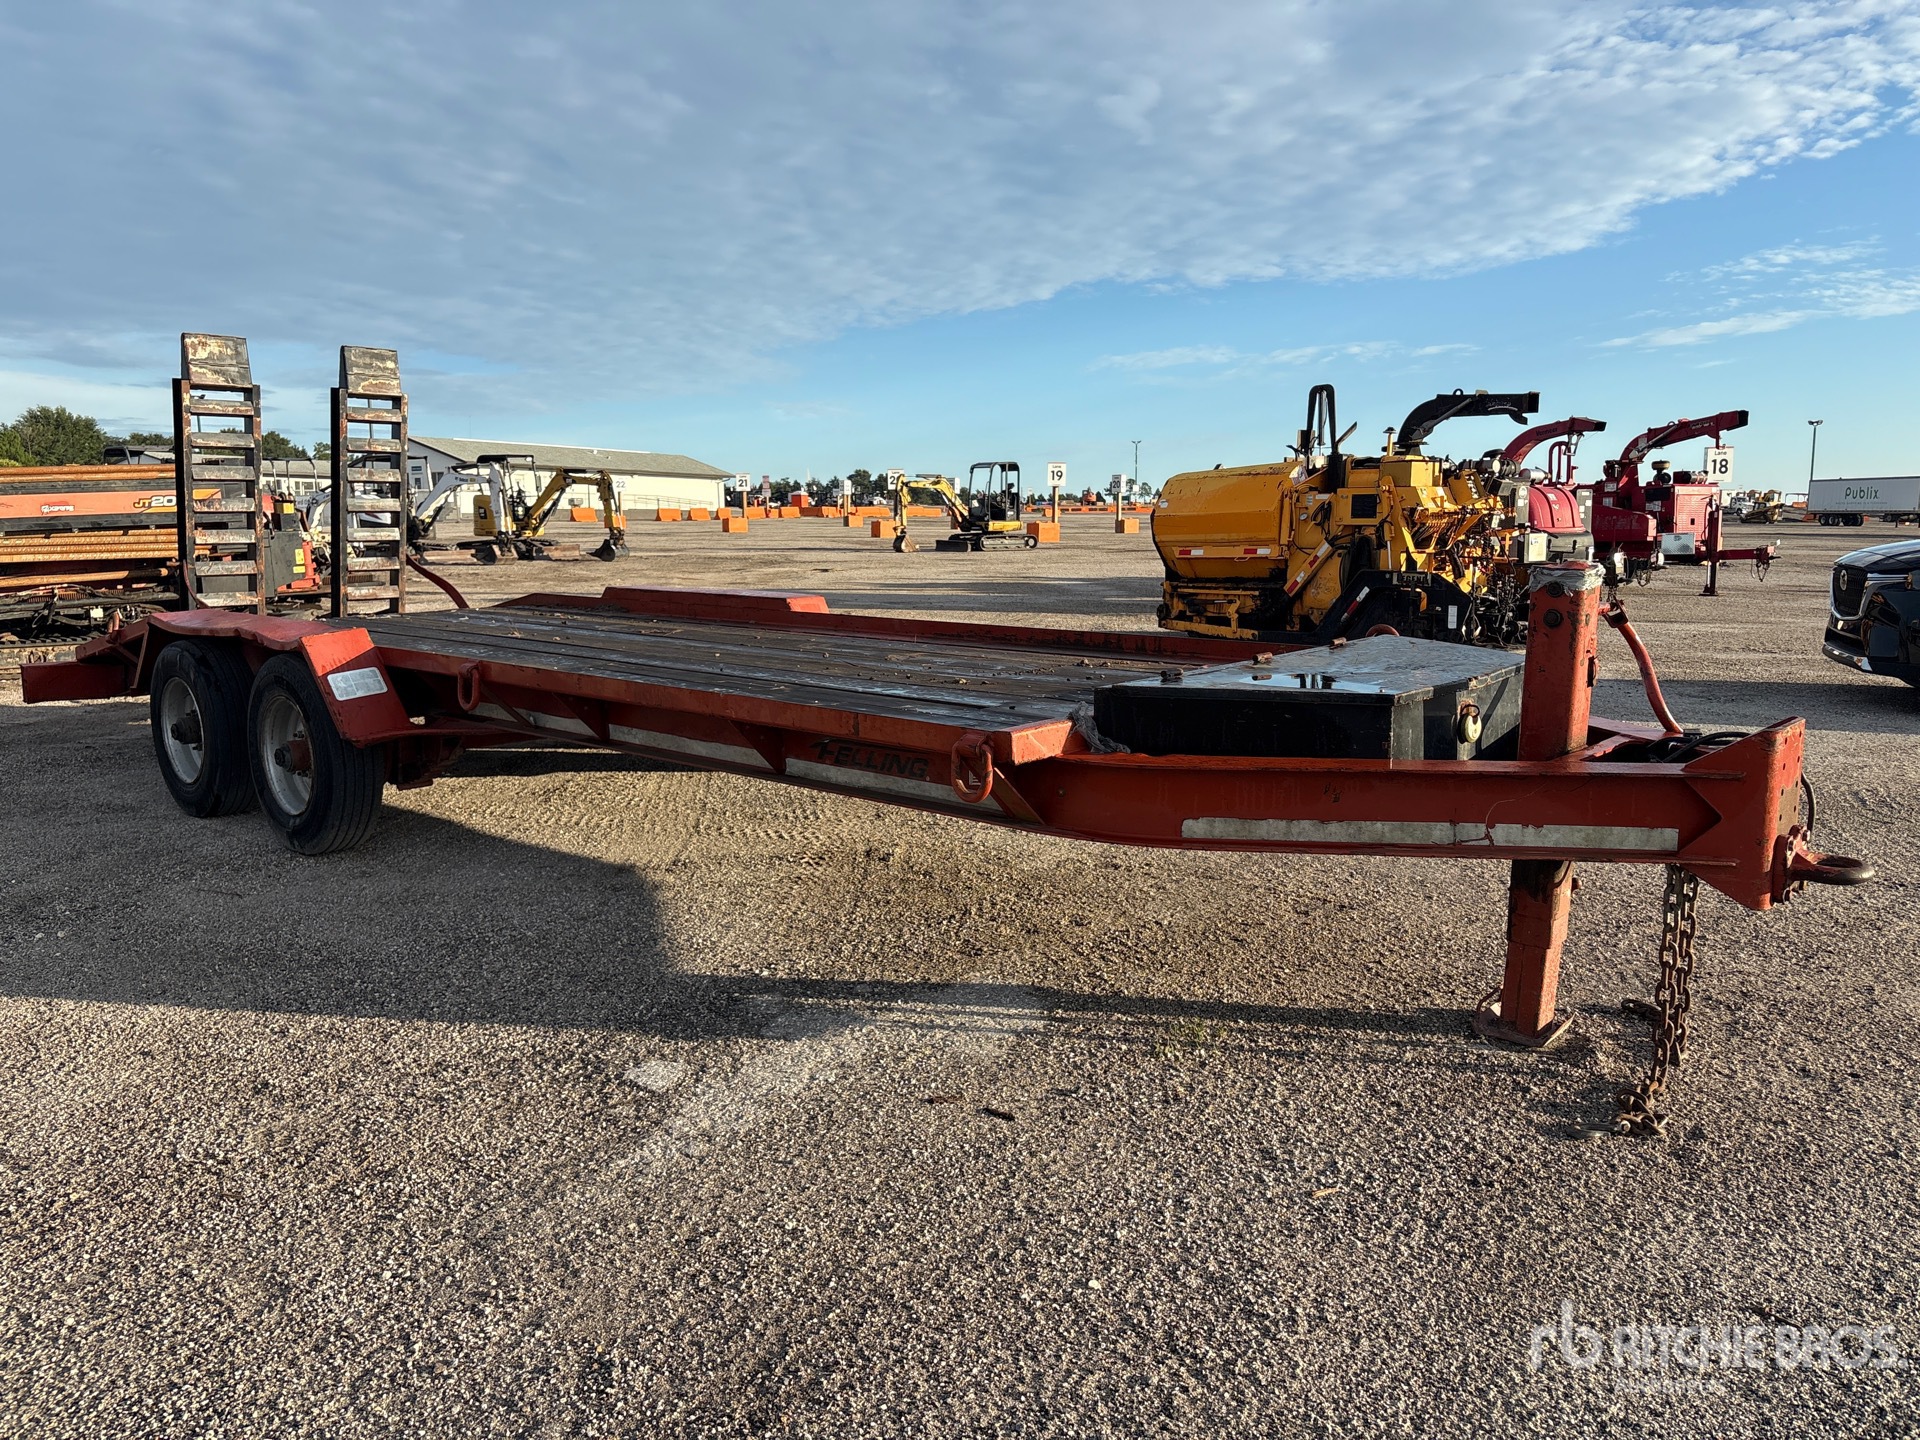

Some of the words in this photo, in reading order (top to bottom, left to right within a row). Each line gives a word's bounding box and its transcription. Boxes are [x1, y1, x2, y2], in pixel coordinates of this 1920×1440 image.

[1711, 458, 1729, 475] 18
[1050, 470, 1063, 481] 19
[615, 480, 626, 489] 22
[738, 478, 748, 488] 21
[1112, 480, 1121, 489] 20
[1844, 486, 1879, 500] Publix
[133, 495, 177, 509] JT20
[809, 738, 931, 780] FELLING
